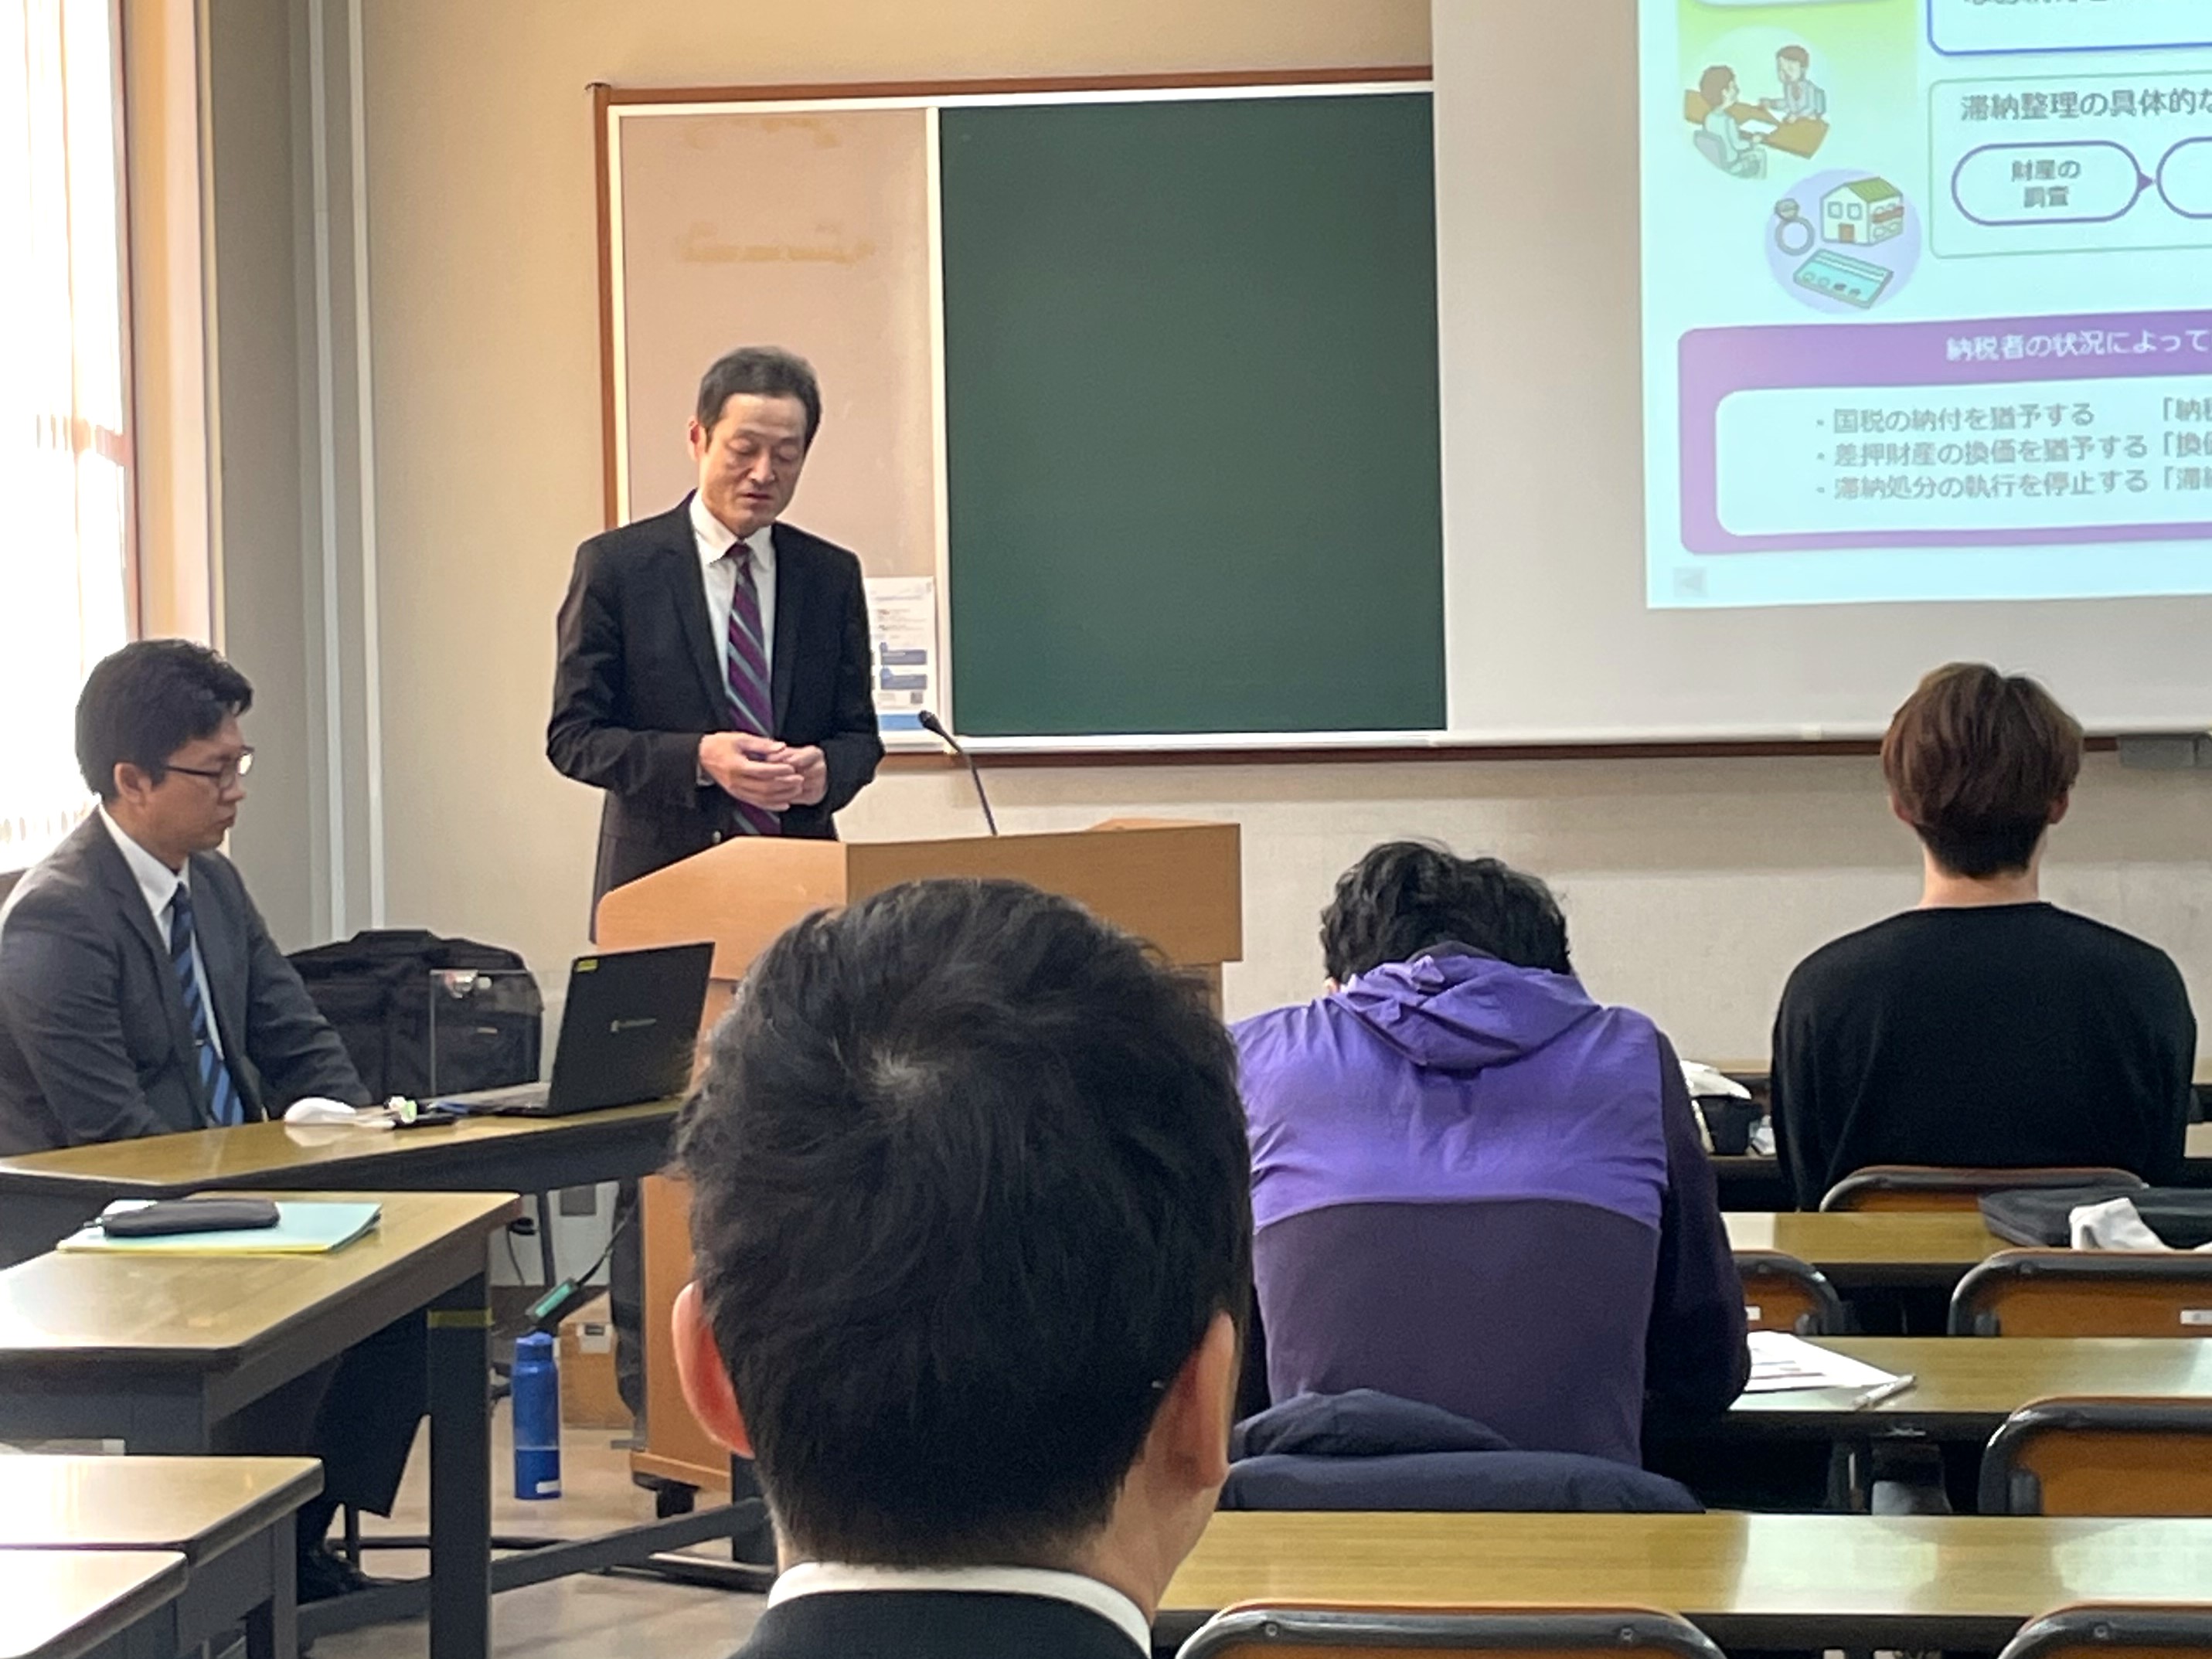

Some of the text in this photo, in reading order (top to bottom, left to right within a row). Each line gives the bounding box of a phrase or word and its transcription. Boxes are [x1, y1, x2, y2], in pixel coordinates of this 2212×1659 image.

[2011, 159, 2081, 182] 財産の
[1945, 329, 2209, 361] 納税者の状況によって
